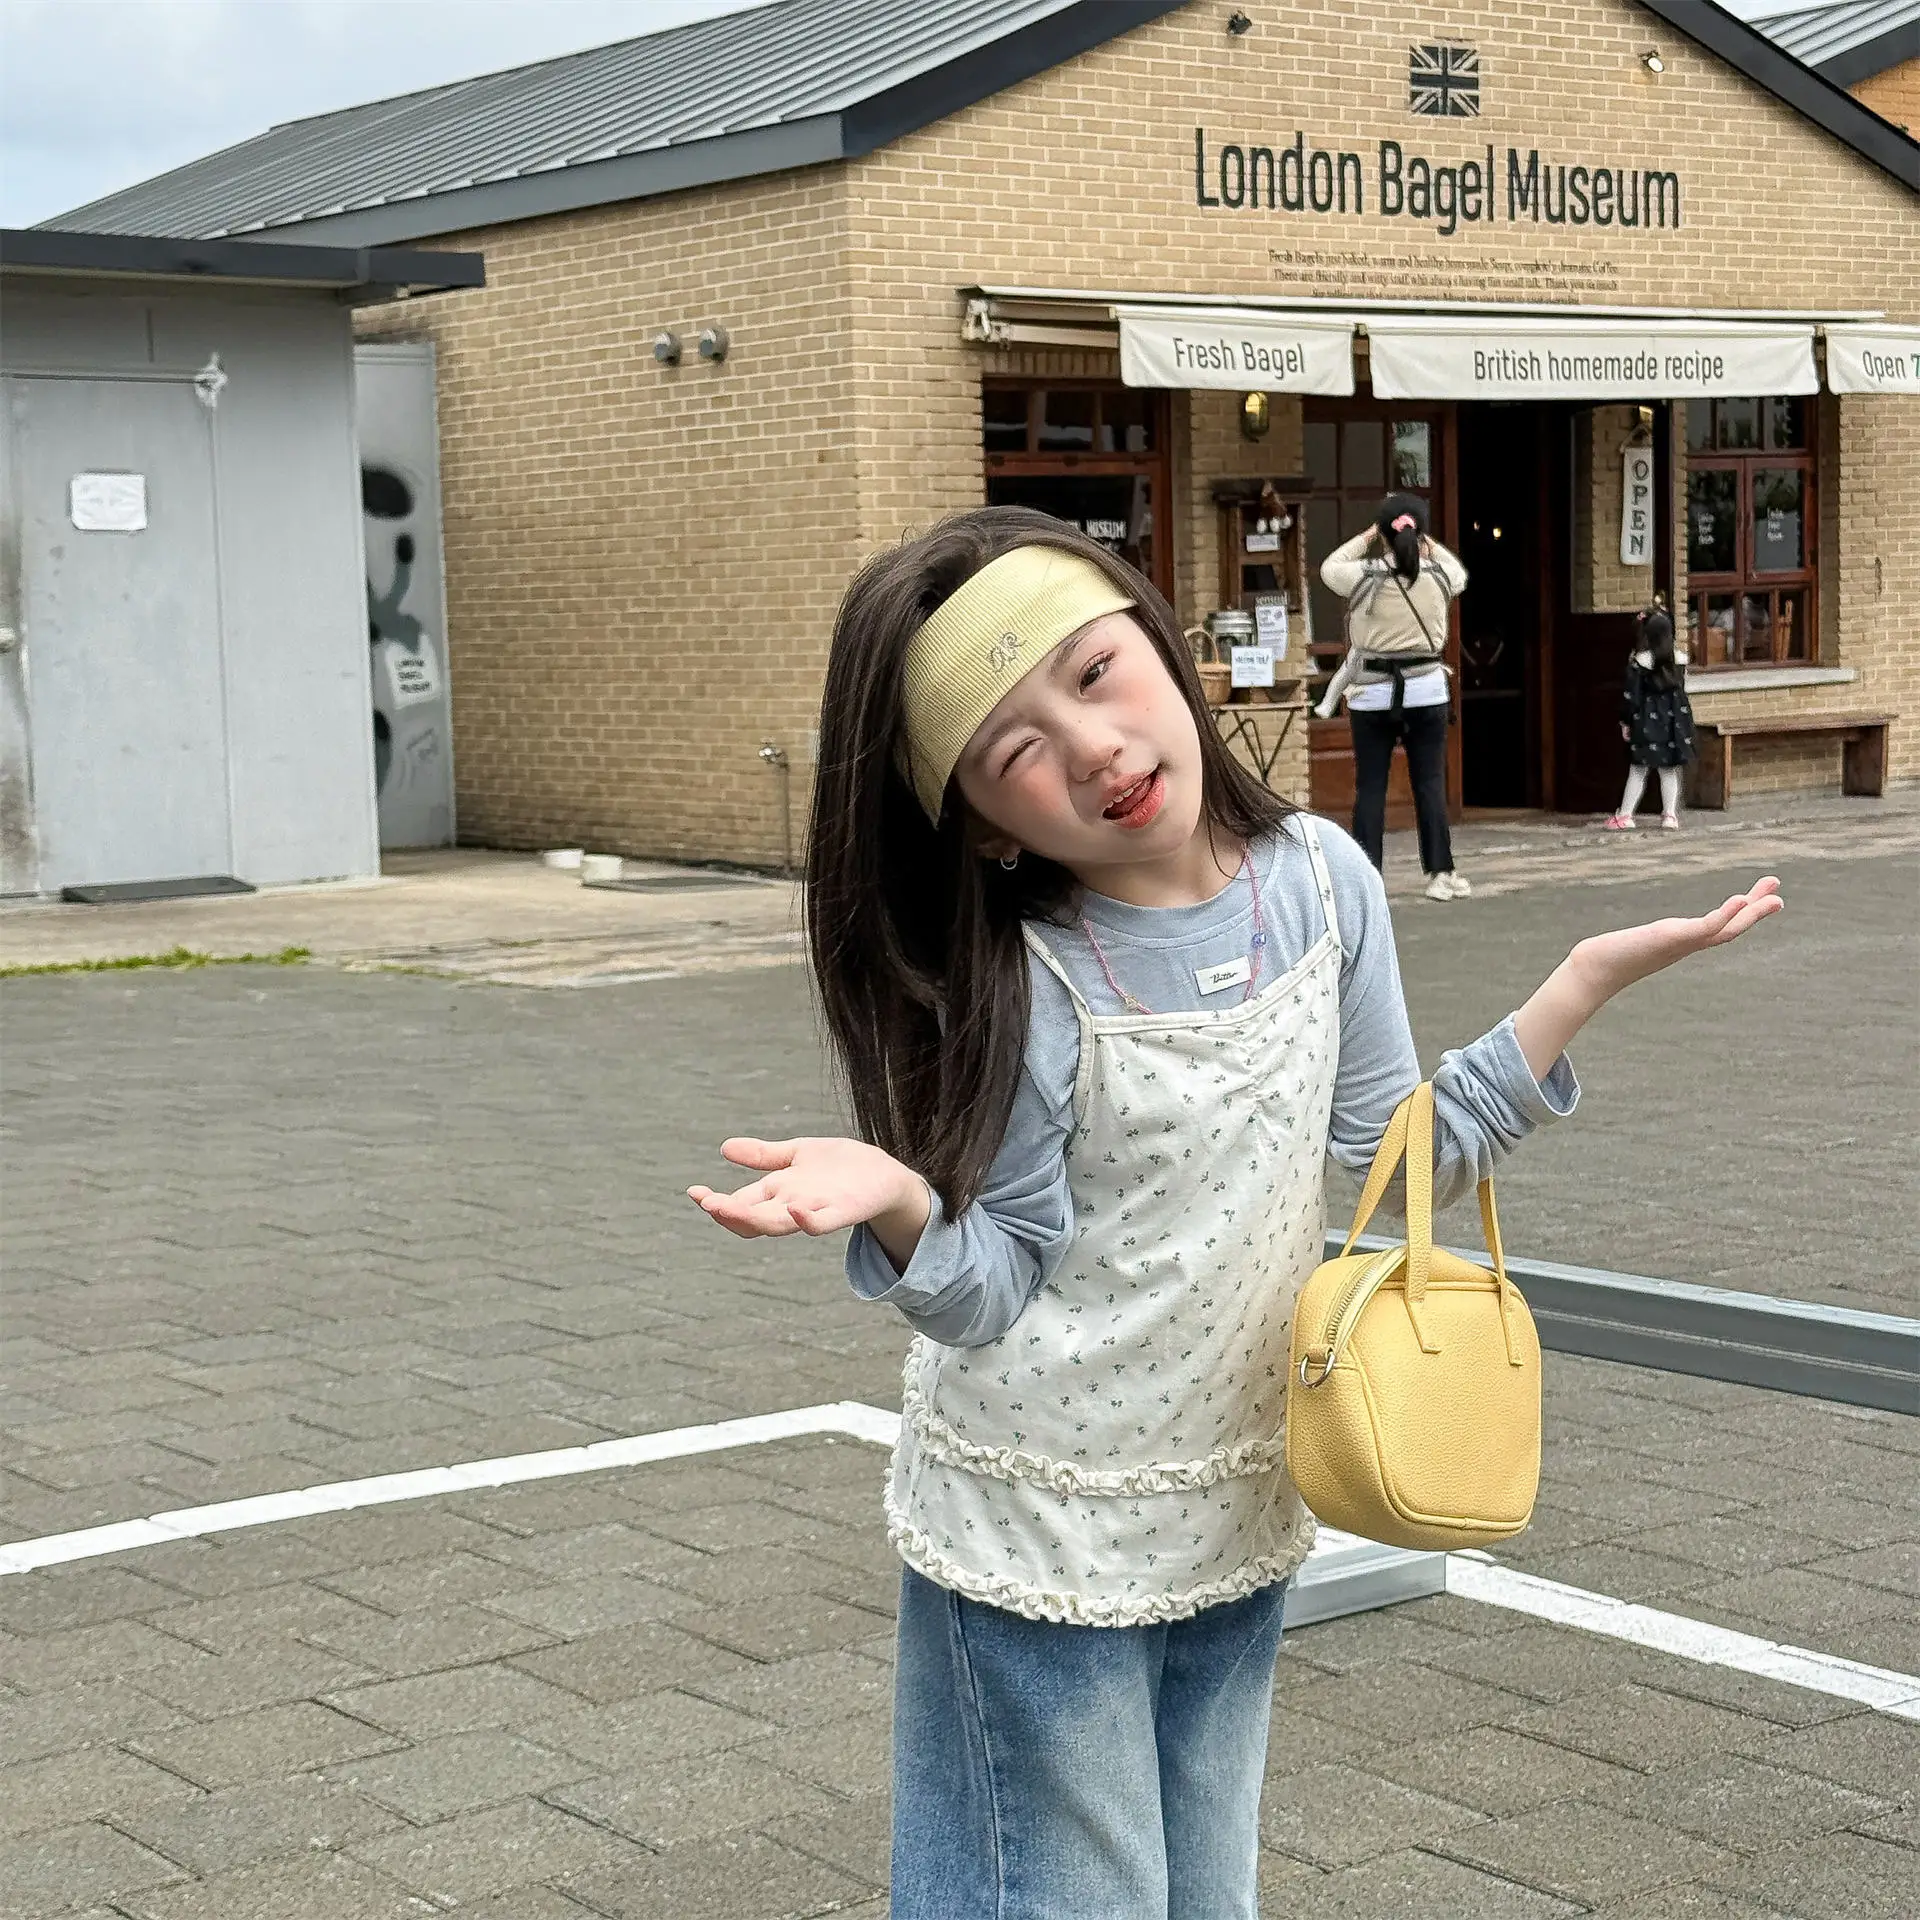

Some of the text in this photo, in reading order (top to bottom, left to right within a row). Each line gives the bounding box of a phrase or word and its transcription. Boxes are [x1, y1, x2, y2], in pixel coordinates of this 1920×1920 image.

[1195, 128, 1679, 236] London Bagel Museum
[1268, 249, 1293, 263] Fresh
[1274, 268, 1297, 282] There
[1173, 337, 1305, 380] Fresh Bagel
[1474, 349, 1723, 386] British homemade recipe
[1862, 350, 1907, 383] Open
[1629, 459, 1649, 556] OPEN
